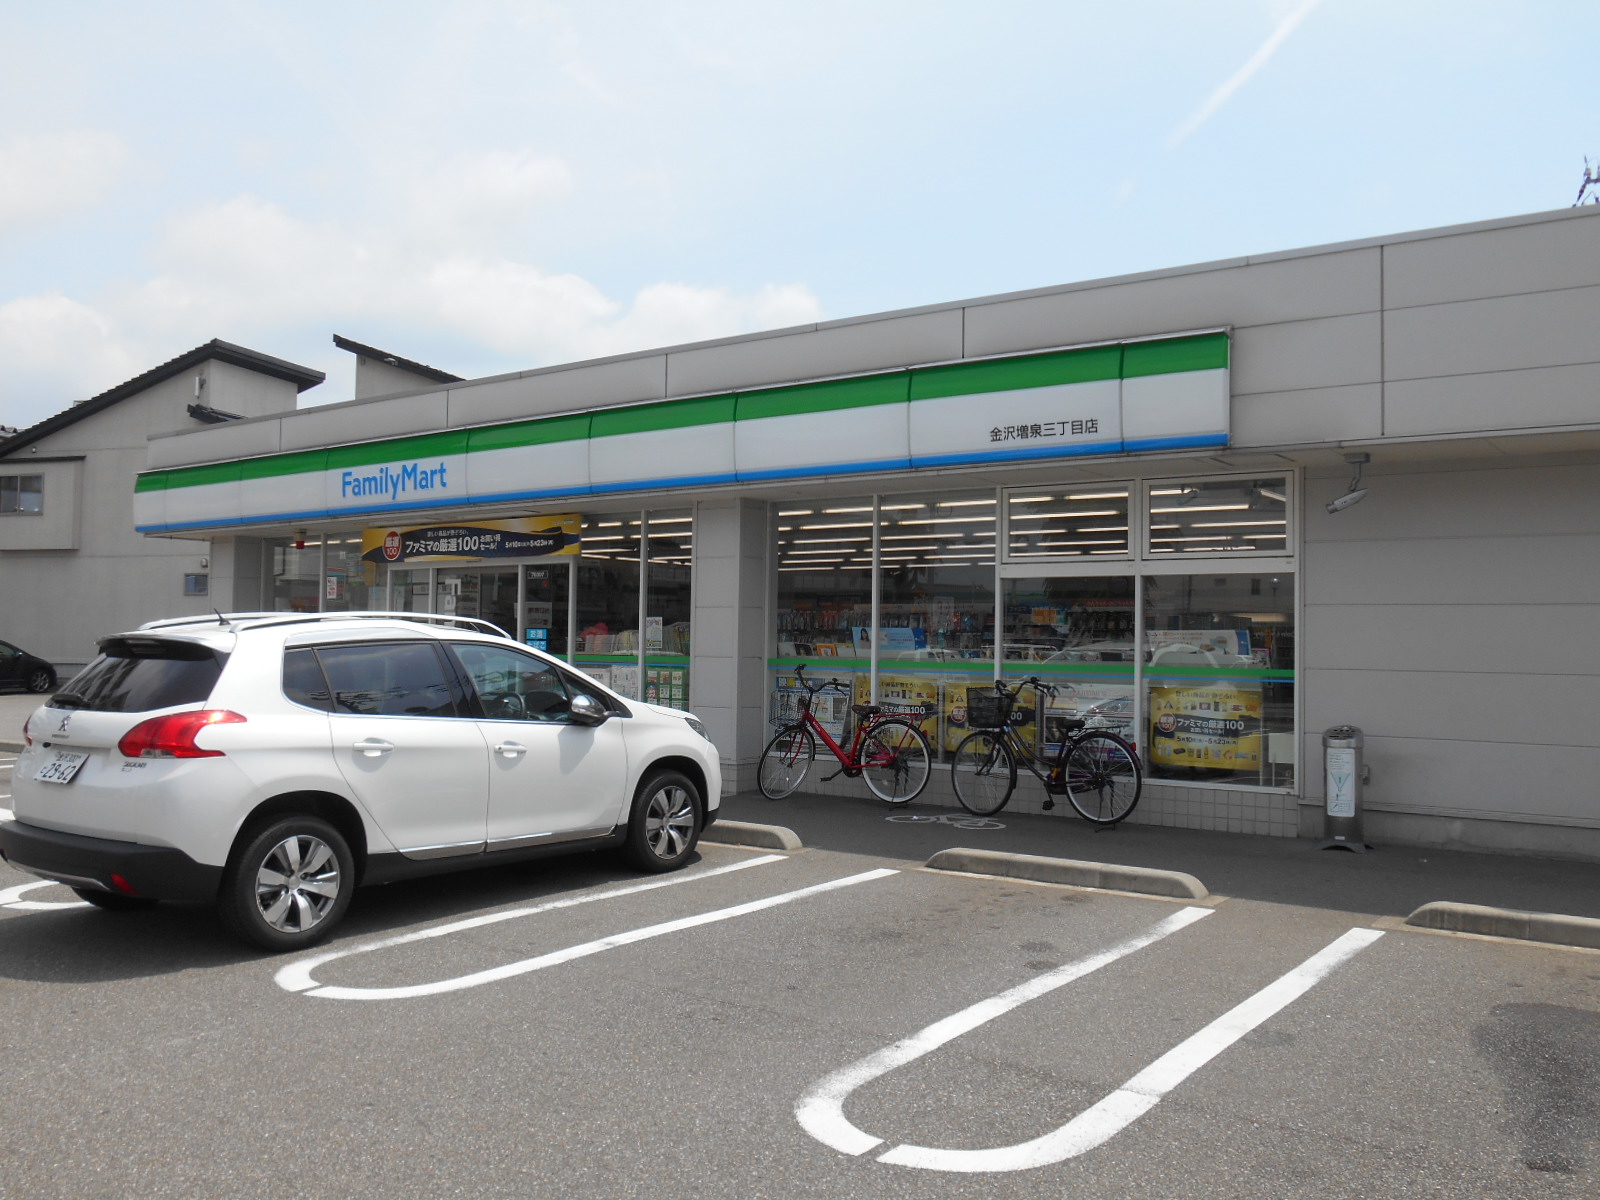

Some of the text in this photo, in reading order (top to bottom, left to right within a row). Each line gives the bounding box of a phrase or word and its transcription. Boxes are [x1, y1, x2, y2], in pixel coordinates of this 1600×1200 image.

[990, 419, 1098, 442] 金沢増泉三丁目店
[342, 462, 447, 500] FamilyMart
